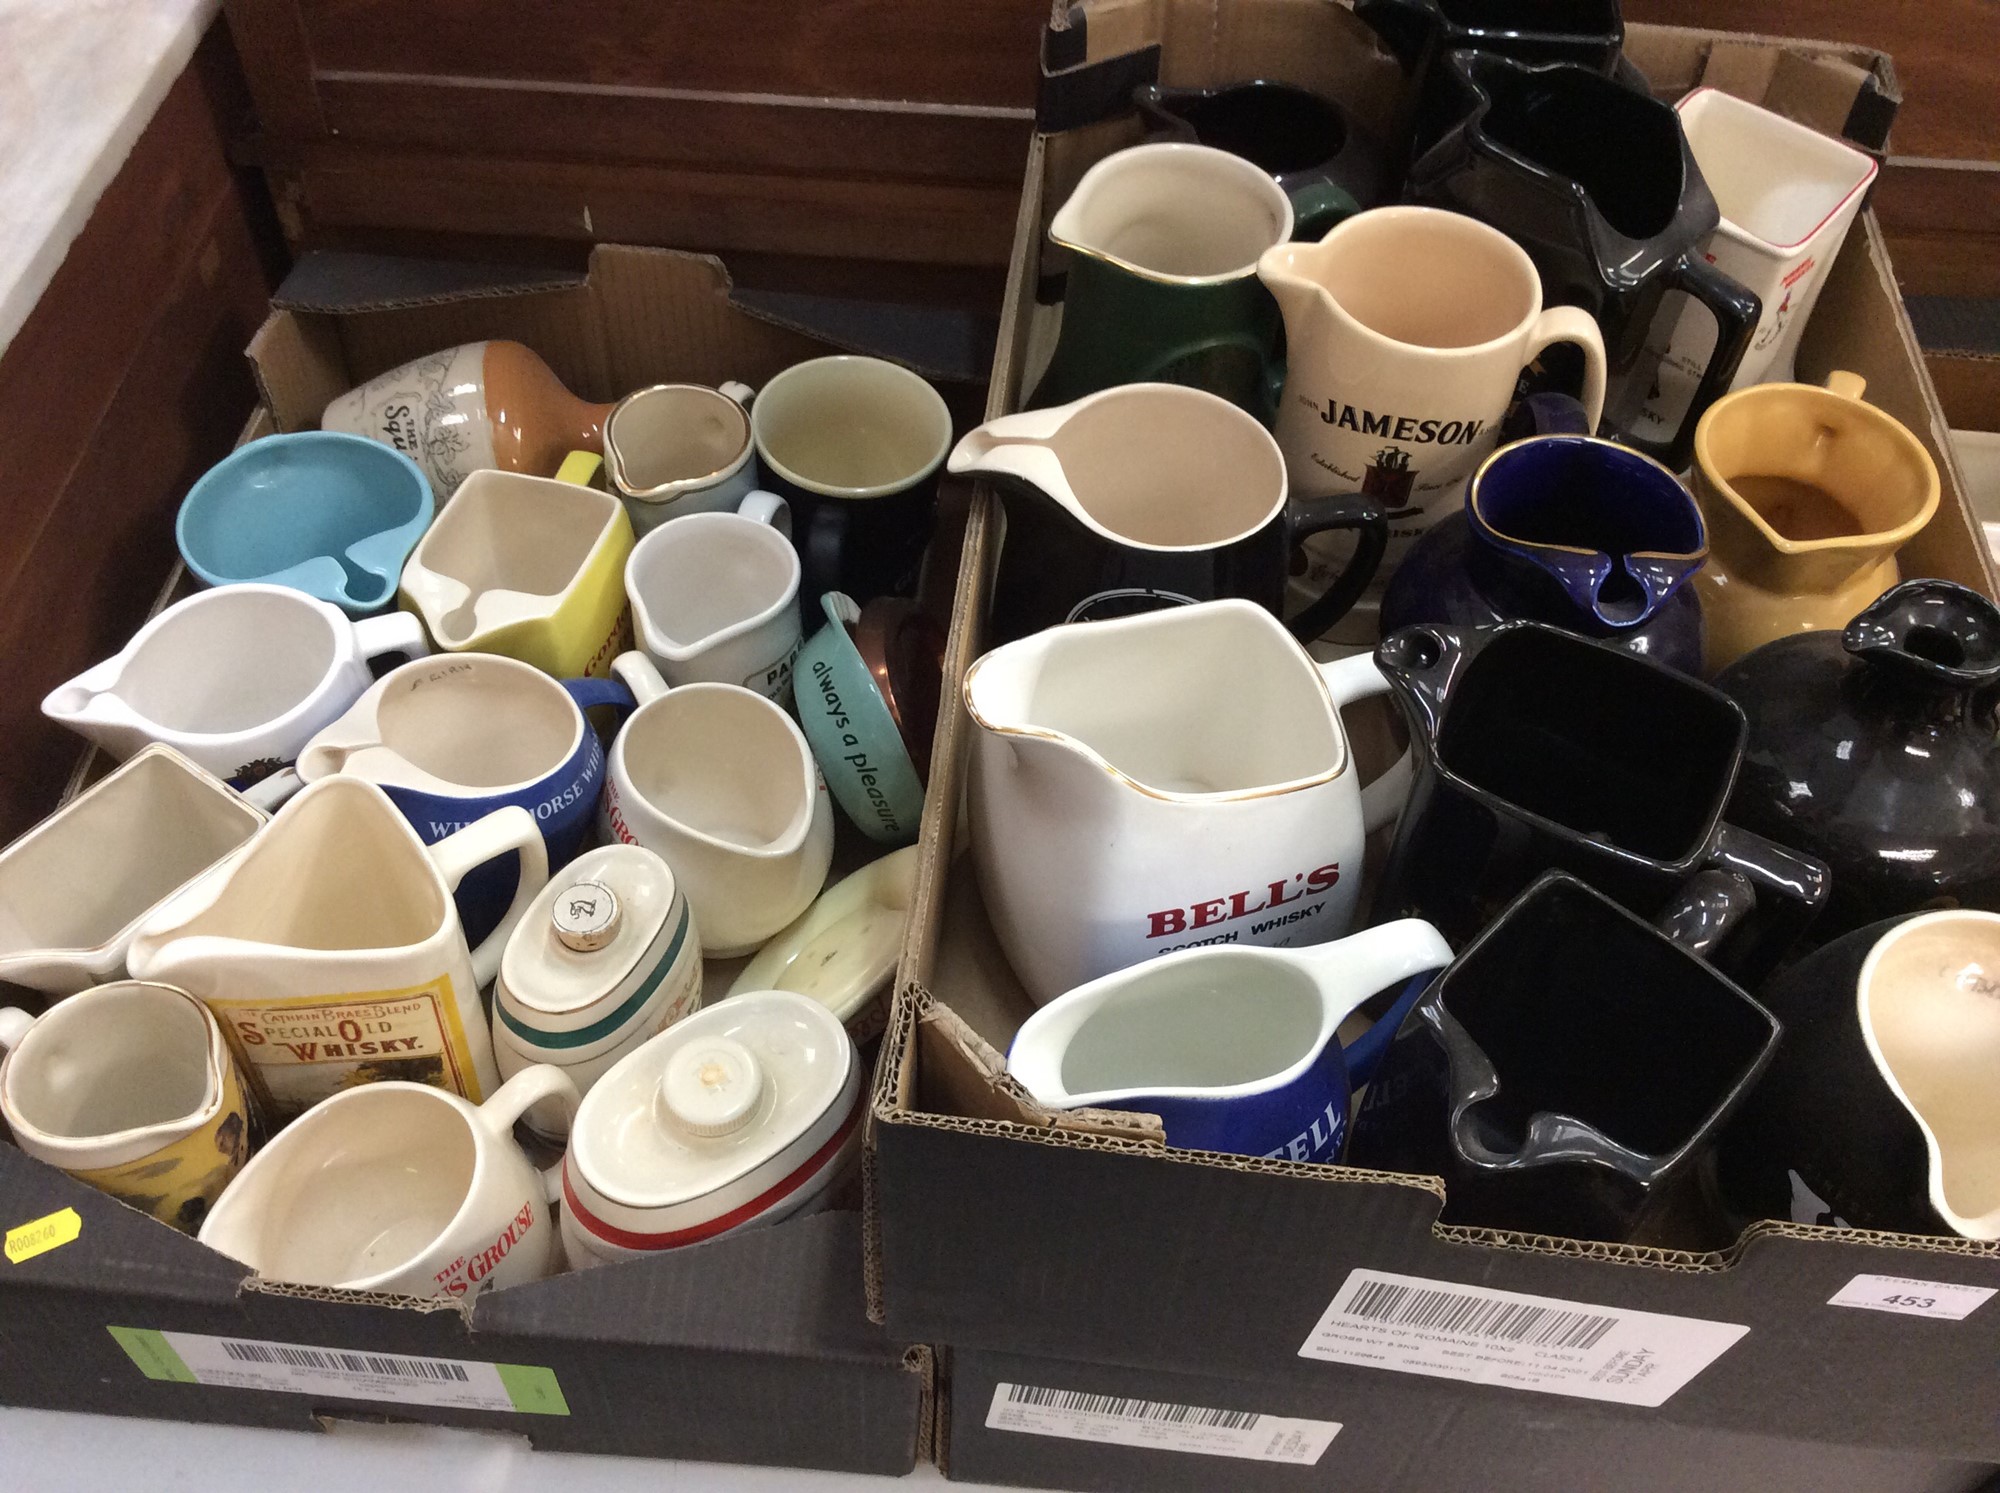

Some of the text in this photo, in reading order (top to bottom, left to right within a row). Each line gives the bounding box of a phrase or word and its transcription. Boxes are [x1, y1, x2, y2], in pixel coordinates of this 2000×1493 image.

[382, 405, 410, 451] Squ
[406, 418, 418, 451] THE
[1320, 398, 1484, 446] JAMESON
[811, 660, 900, 832] always a pleasure
[1145, 861, 1341, 940] BELL'S
[1250, 901, 1326, 936] WHISKY
[372, 1002, 421, 1019] BLEND
[237, 1019, 392, 1046] SPECIAL OLD
[467, 1200, 535, 1283] GROUSE
[433, 1255, 466, 1284] THE
[1882, 1294, 1936, 1309] 453
[1321, 1332, 1364, 1343] GROSS
[1366, 1338, 1385, 1347] WT
[1441, 1349, 1474, 1359] BEST
[1330, 1320, 1387, 1334] HEARTS
[1391, 1327, 1410, 1337] OF
[1414, 1331, 1479, 1348] ROMAINE
[1534, 1350, 1576, 1363] CLASS
[1606, 1347, 1656, 1384] SUNDAY
